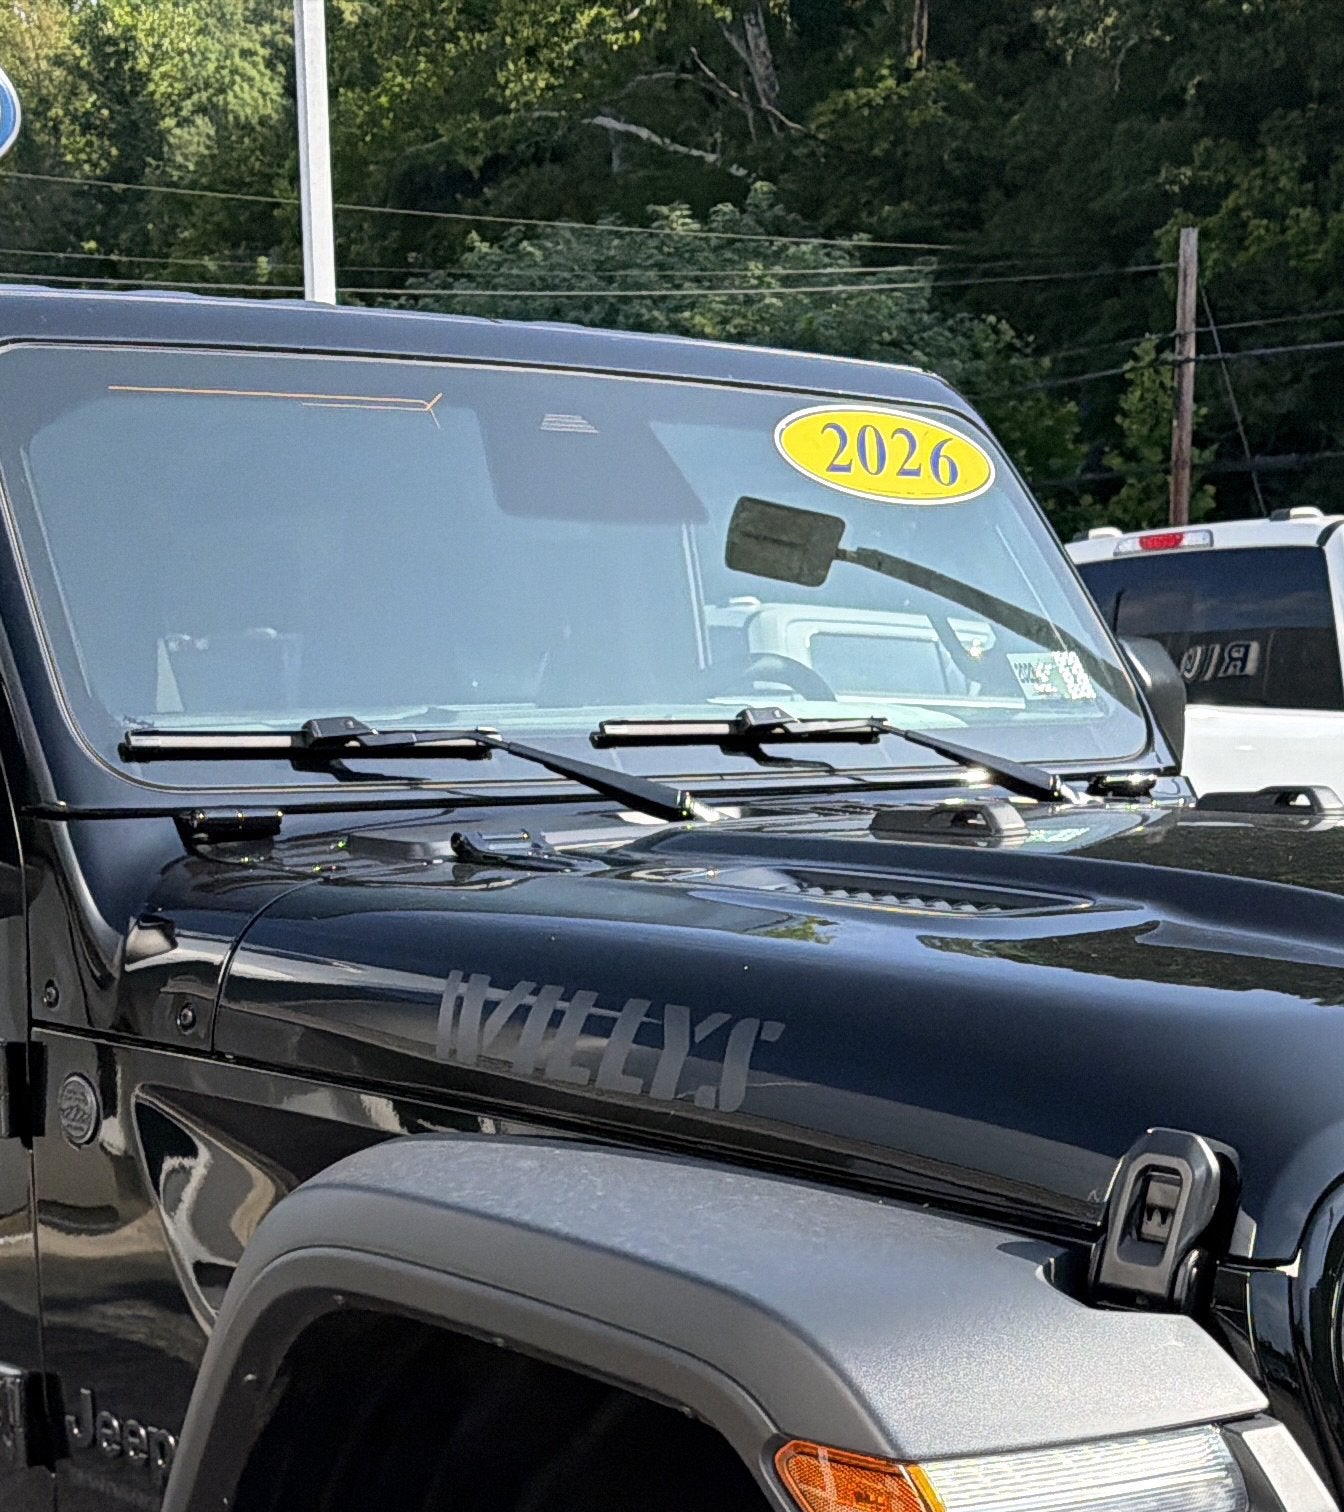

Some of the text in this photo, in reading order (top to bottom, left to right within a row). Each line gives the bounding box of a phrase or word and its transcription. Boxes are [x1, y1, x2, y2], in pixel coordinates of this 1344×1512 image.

[820, 422, 959, 487] 2026
[435, 969, 787, 1113] WILLYS
[64, 1387, 177, 1482] Jeep
